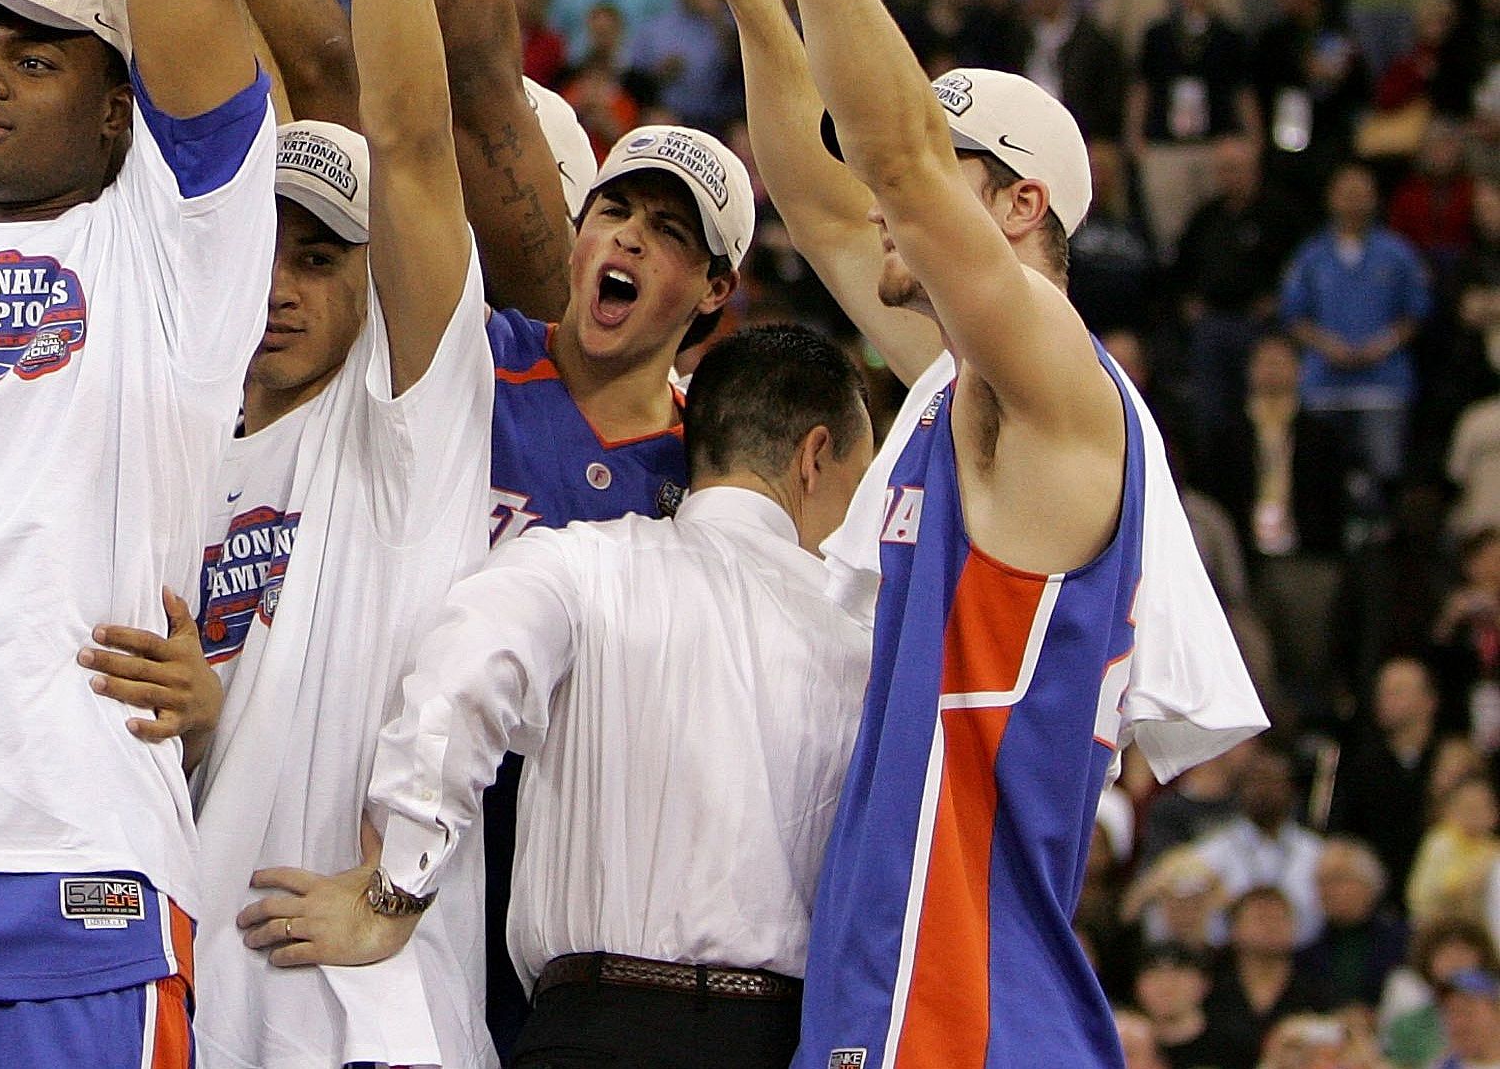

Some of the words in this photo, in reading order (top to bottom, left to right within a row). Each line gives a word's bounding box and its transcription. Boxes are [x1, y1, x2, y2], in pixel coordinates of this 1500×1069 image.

[281, 140, 343, 167] NATIONAL
[665, 137, 721, 178] NATIONAL
[657, 145, 725, 198] CHAMPIONS
[67, 884, 104, 905] 54
[104, 883, 138, 896] NIKE
